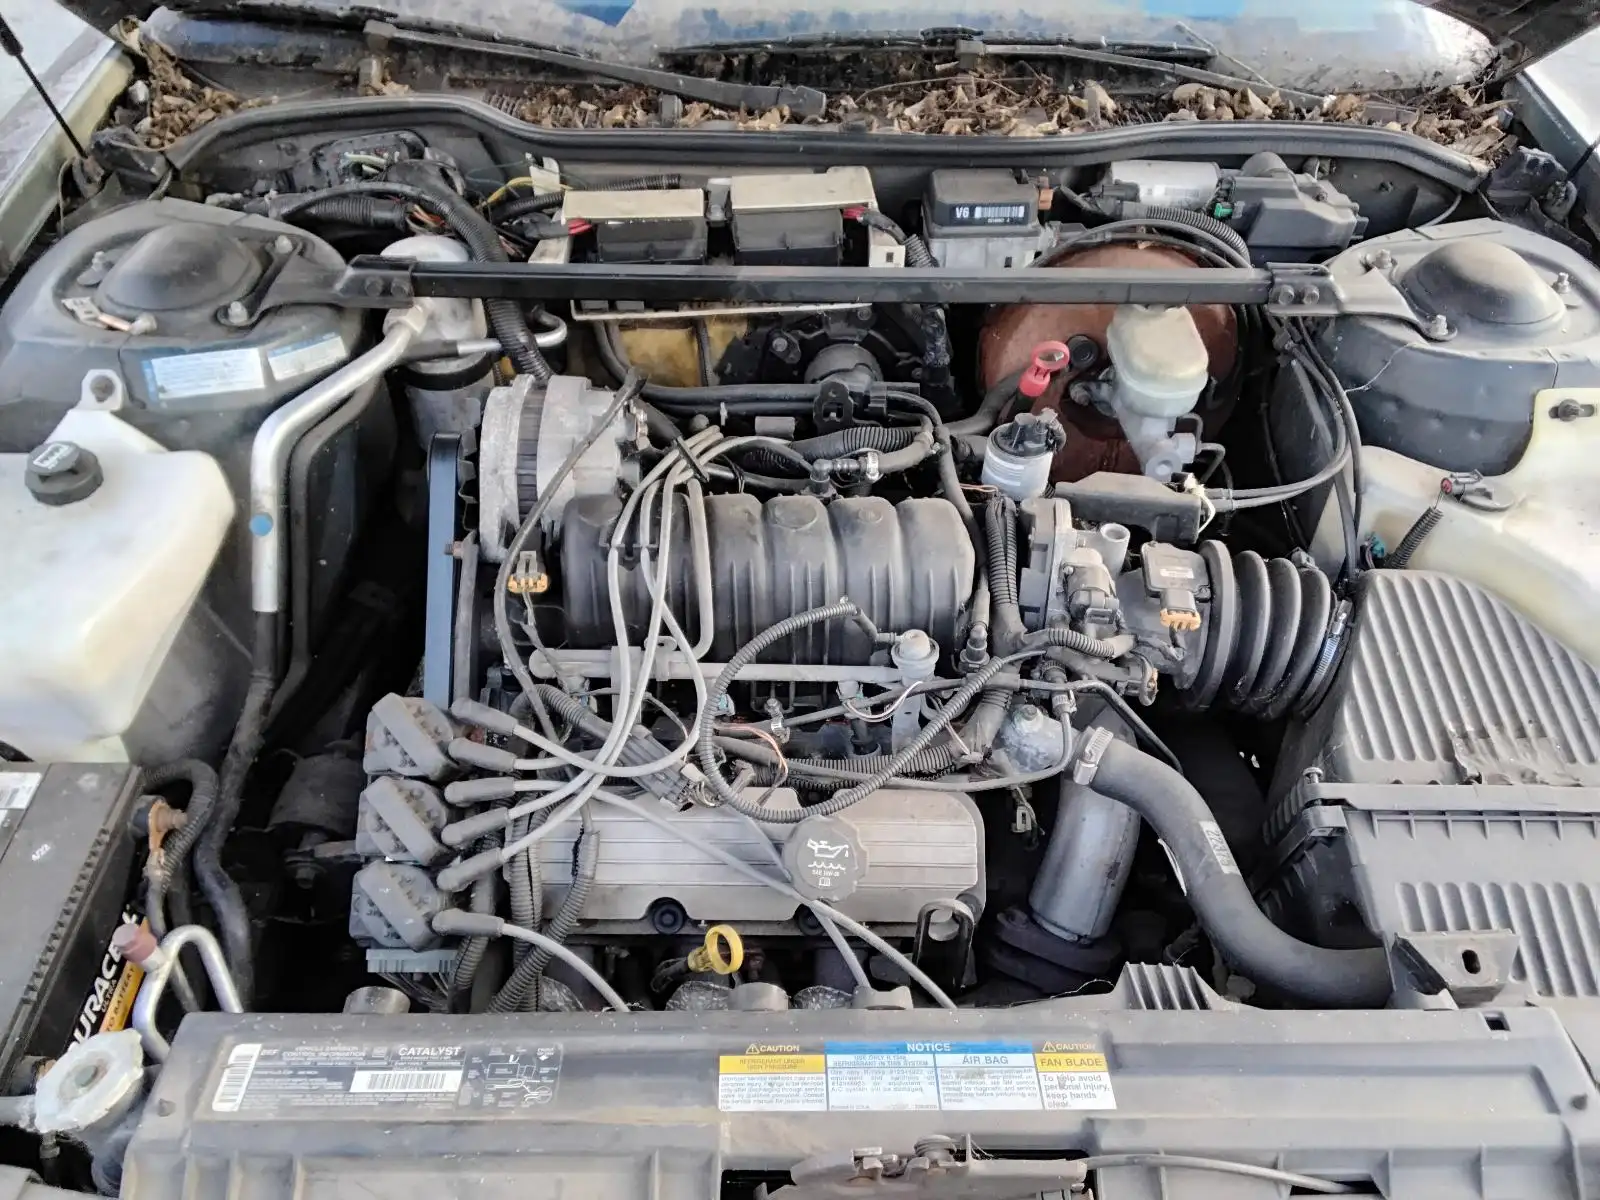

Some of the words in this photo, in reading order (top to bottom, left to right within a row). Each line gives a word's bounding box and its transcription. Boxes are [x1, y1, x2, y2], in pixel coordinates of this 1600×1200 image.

[955, 206, 970, 219] V6
[113, 966, 136, 1014] BATTERY
[398, 1046, 462, 1056] CATALYST
[760, 1044, 800, 1053] CAUTION
[906, 1042, 952, 1053] NOTICE
[1056, 1043, 1096, 1051] CAUTION
[962, 1056, 981, 1065] AIR
[984, 1056, 1009, 1065] BAG
[1040, 1058, 1062, 1067] FAN
[1065, 1058, 1103, 1067] BLADE
[1083, 1083, 1110, 1091] injury,
[1046, 1091, 1068, 1100] keep
[1069, 1091, 1097, 1099] hands
